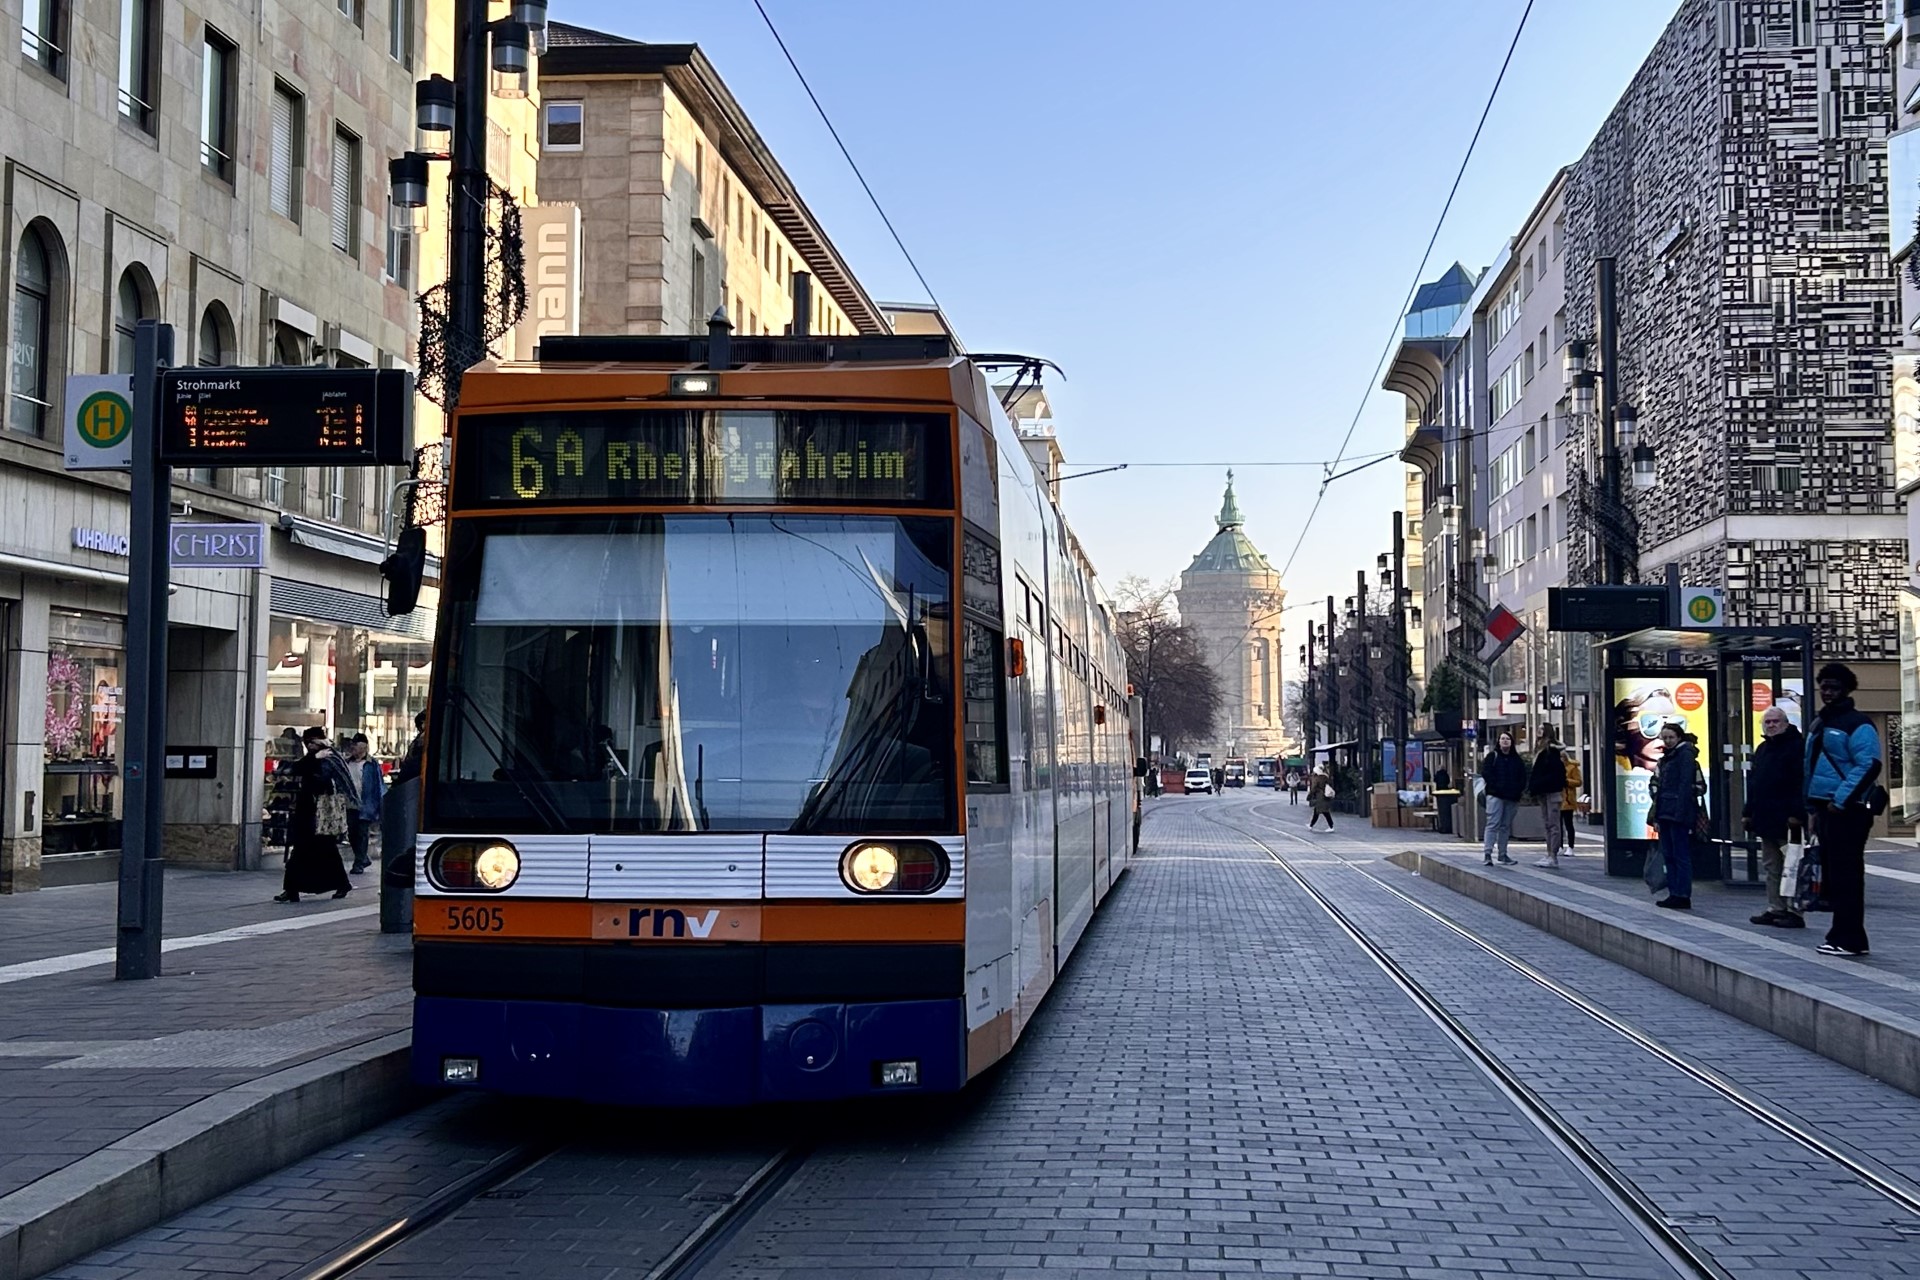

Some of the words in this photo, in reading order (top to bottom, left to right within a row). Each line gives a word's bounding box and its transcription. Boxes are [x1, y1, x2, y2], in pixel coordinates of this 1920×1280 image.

[176, 380, 241, 391] Strohmarkt
[173, 533, 258, 558] CHRIST
[447, 906, 504, 931] 5605
[628, 908, 720, 938] rnv
